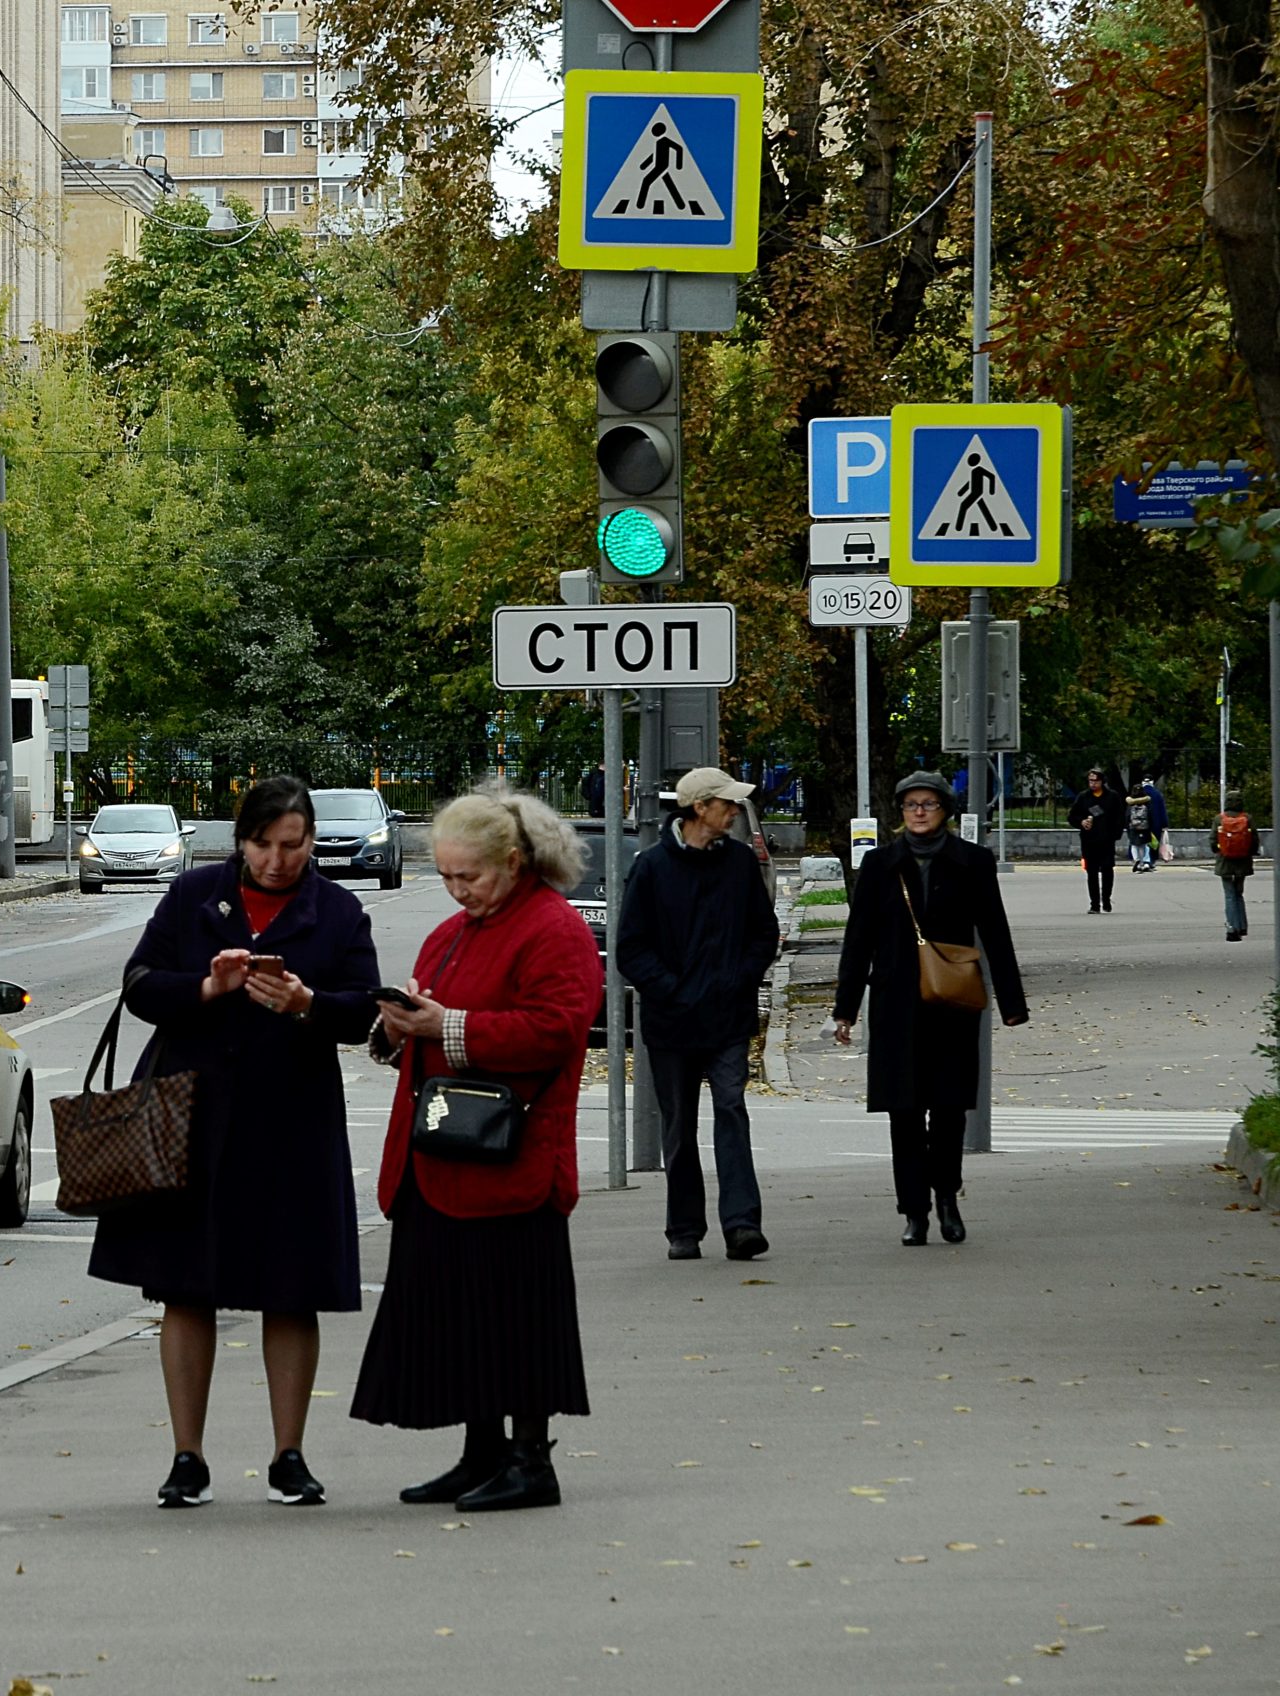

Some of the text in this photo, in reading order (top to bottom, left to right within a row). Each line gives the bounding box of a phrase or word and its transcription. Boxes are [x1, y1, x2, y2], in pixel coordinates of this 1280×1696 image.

[837, 432, 887, 503] P
[1166, 476, 1204, 485] Тверского
[822, 590, 897, 610] 10 15 20
[528, 621, 699, 674] СТОП
[580, 909, 605, 921] 153А
